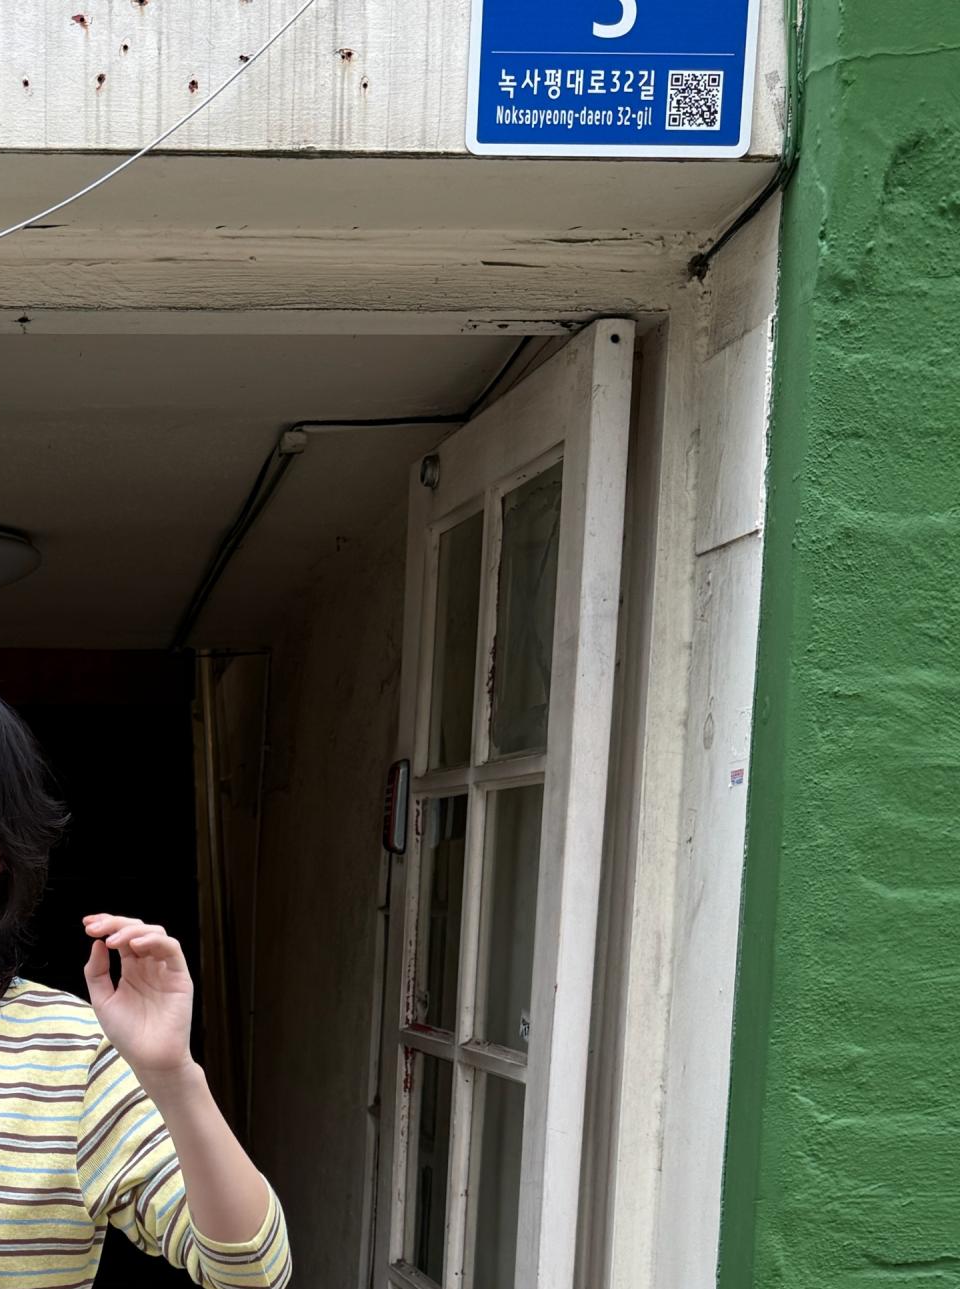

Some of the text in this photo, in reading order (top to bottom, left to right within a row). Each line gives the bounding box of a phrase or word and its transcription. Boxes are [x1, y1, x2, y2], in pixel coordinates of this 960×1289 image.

[498, 68, 655, 100] 녹사평대로32길
[496, 105, 652, 130] Noksapyeong-daero 32-gil
